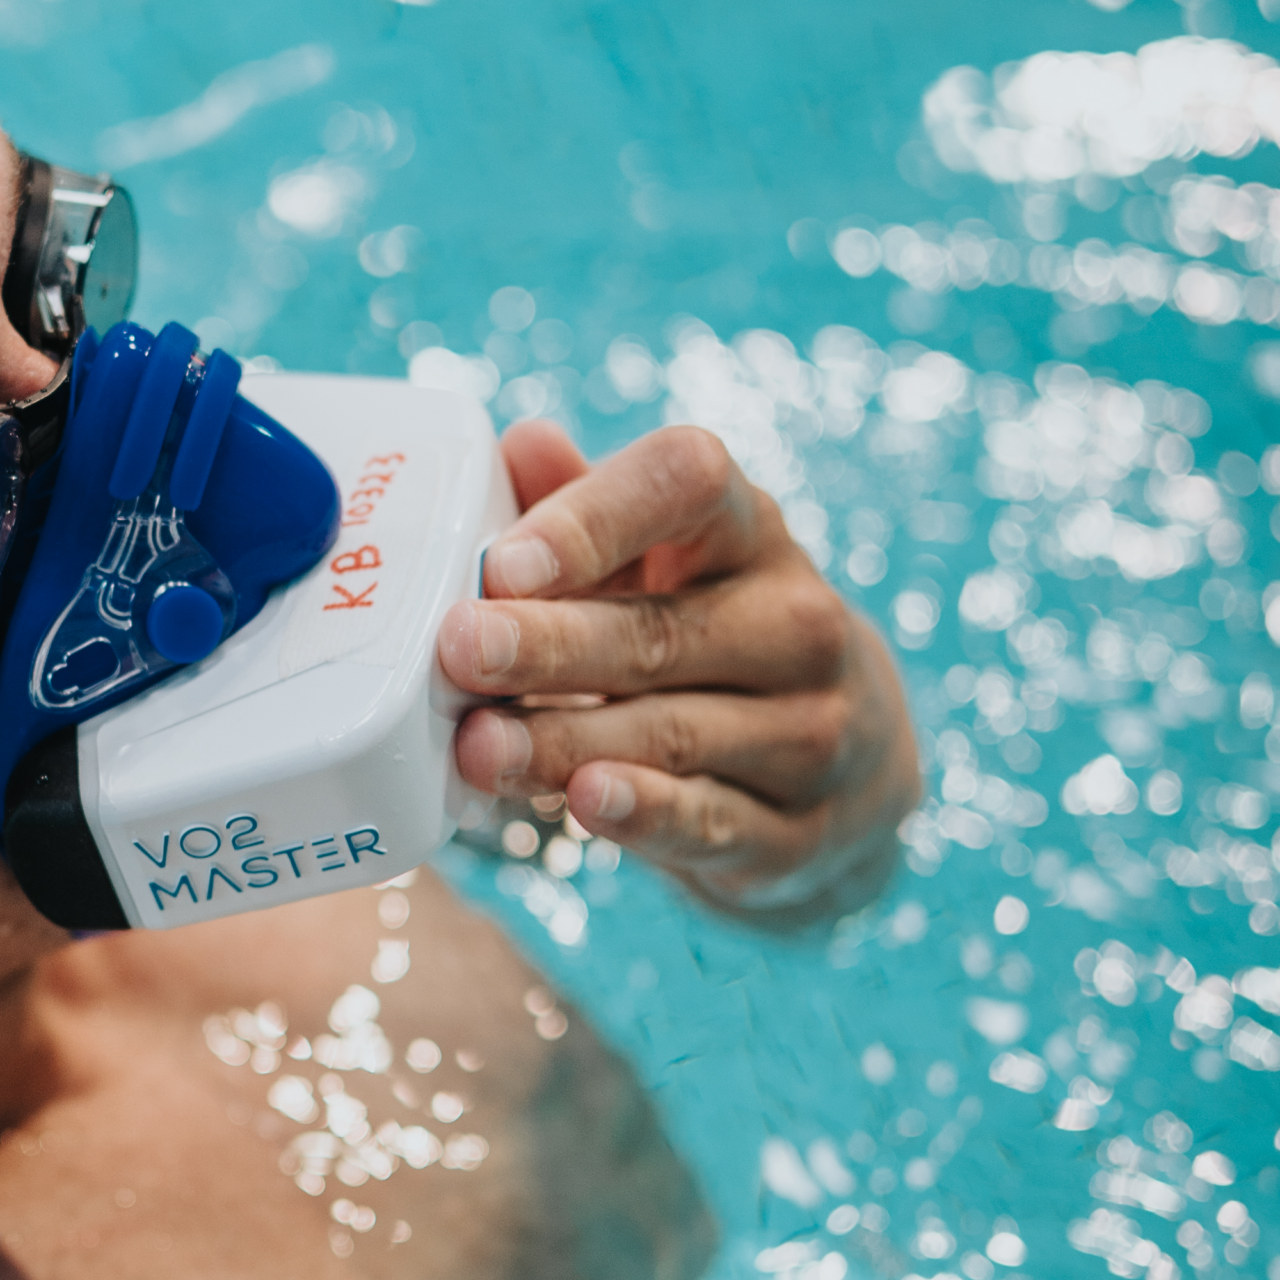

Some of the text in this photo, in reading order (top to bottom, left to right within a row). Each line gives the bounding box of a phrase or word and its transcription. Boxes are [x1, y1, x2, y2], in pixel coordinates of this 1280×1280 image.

[322, 543, 383, 611] KB
[132, 813, 266, 869] VO2
[148, 825, 387, 911] MASTER
